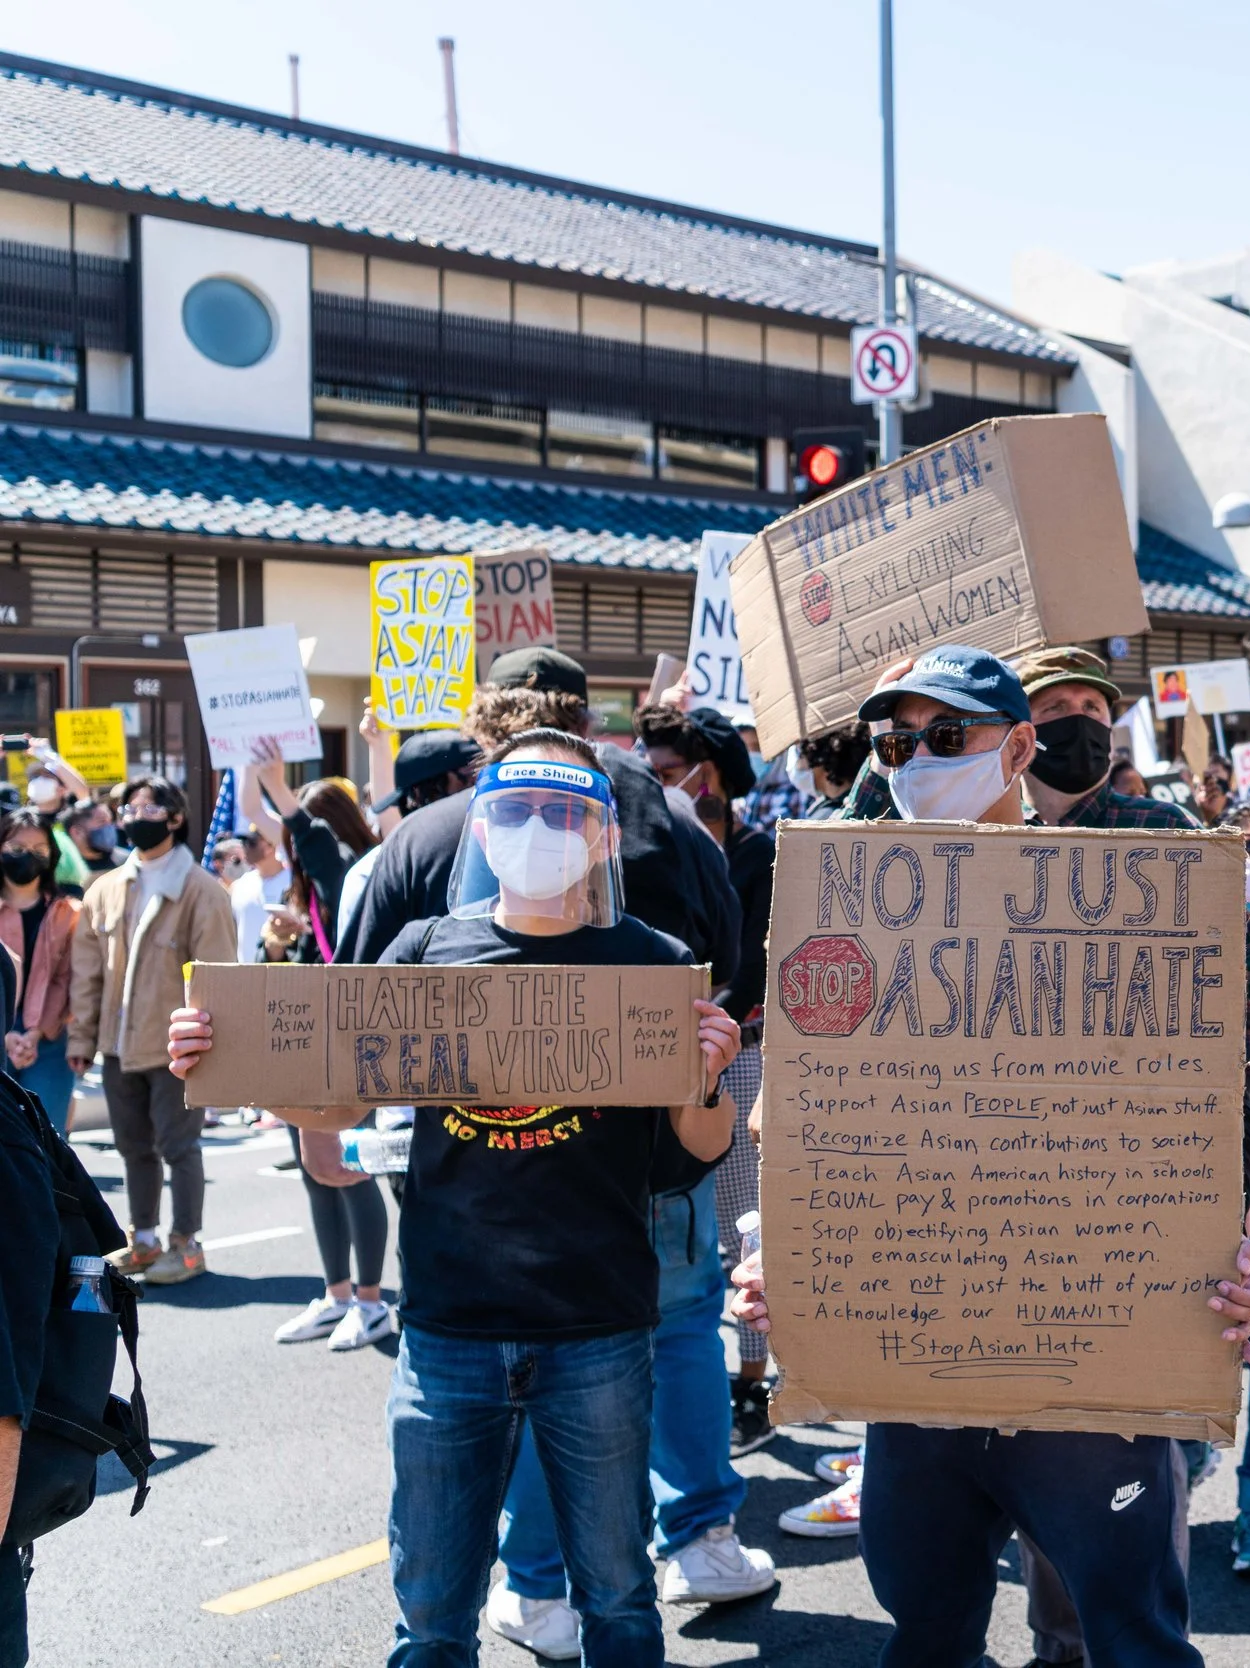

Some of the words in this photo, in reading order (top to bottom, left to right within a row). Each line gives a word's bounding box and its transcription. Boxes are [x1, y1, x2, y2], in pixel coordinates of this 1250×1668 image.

[790, 476, 897, 570] WHITE
[838, 517, 984, 614] EXPLOITING
[377, 567, 470, 617] STOP
[475, 600, 554, 643] SIAN
[838, 616, 921, 683] ASIAN
[915, 566, 1021, 638] WOMEN
[376, 620, 471, 672] ASIAN
[384, 673, 463, 722] HATE
[505, 768, 537, 777] Face
[542, 768, 588, 784] Shield
[1151, 782, 1191, 804] OP
[817, 841, 975, 930] NOT
[1004, 846, 1203, 927] JUST
[337, 976, 446, 1031] HATE
[455, 974, 493, 1028] IS
[506, 973, 586, 1026] THE
[784, 960, 866, 1007] STOP
[871, 938, 1067, 1040] ASIAN
[1083, 941, 1225, 1038] HATE
[267, 1000, 311, 1016] #STOP
[627, 1005, 674, 1024] #STOP
[272, 1017, 315, 1034] ASIAN
[633, 1027, 678, 1042] ASIAN
[271, 1036, 312, 1053] HATE
[634, 1042, 679, 1061] HATE
[355, 1033, 478, 1096] REAL
[486, 1028, 612, 1094] VIRUS
[860, 1059, 941, 1089] erasing
[953, 1062, 981, 1076] us
[990, 1052, 1046, 1077] from
[1054, 1057, 1124, 1076] movie
[891, 1094, 953, 1115] Asian
[1052, 1101, 1077, 1116] not
[1082, 1098, 1116, 1118] just
[1124, 1100, 1167, 1116] Asian
[443, 1113, 478, 1141] NO
[487, 1114, 584, 1150] MERCY
[920, 1130, 978, 1152] Asian
[990, 1133, 1108, 1153] contributions
[1118, 1133, 1141, 1153] to
[896, 1161, 955, 1182] Asian
[970, 1165, 1051, 1183] American
[1058, 1165, 1117, 1189] history
[1125, 1167, 1143, 1180] in
[896, 1189, 931, 1216] pay
[941, 1187, 956, 1212] &
[967, 1188, 1071, 1213] promotions
[1086, 1190, 1106, 1207] in
[1117, 1189, 1220, 1207] corporations
[875, 1221, 989, 1246] objectifying
[1000, 1218, 1058, 1238] Asian
[871, 1248, 1008, 1270] emasculating
[1024, 1246, 1079, 1265] Asian
[860, 1276, 893, 1292] are
[910, 1274, 943, 1293] not
[960, 1276, 1008, 1296] just
[1019, 1275, 1046, 1293] the
[1062, 1274, 1101, 1293] butt
[1116, 1274, 1136, 1292] of
[1144, 1276, 1177, 1299] your
[961, 1306, 995, 1320] our
[1016, 1303, 1135, 1323] HUMANITY
[1115, 1481, 1141, 1502] NIKE
